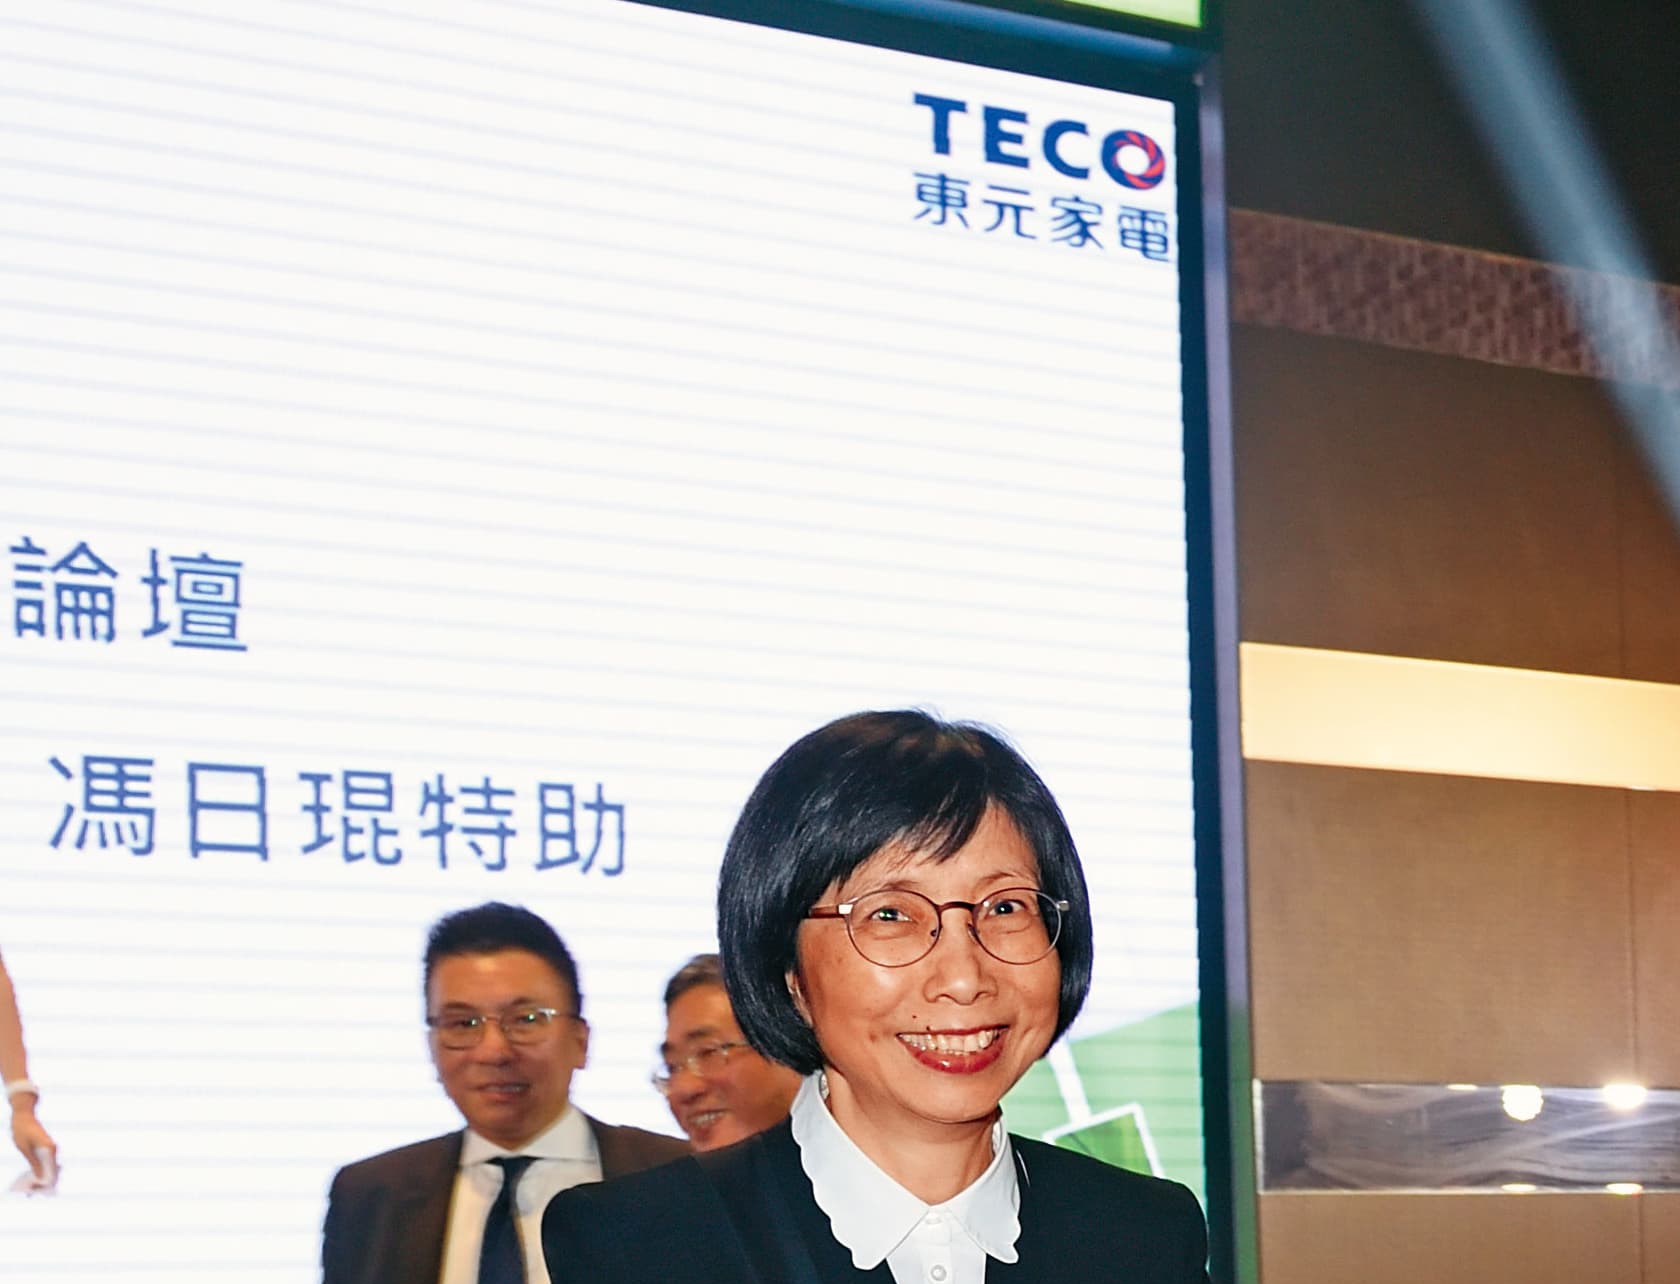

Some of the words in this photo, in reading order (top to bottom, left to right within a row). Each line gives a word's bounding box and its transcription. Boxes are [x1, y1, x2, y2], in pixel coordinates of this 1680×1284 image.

[913, 92, 1167, 190] TECO
[912, 172, 1170, 263] 東元家電
[8, 536, 248, 652] 論壇
[48, 754, 626, 877] 馮日琨特助
